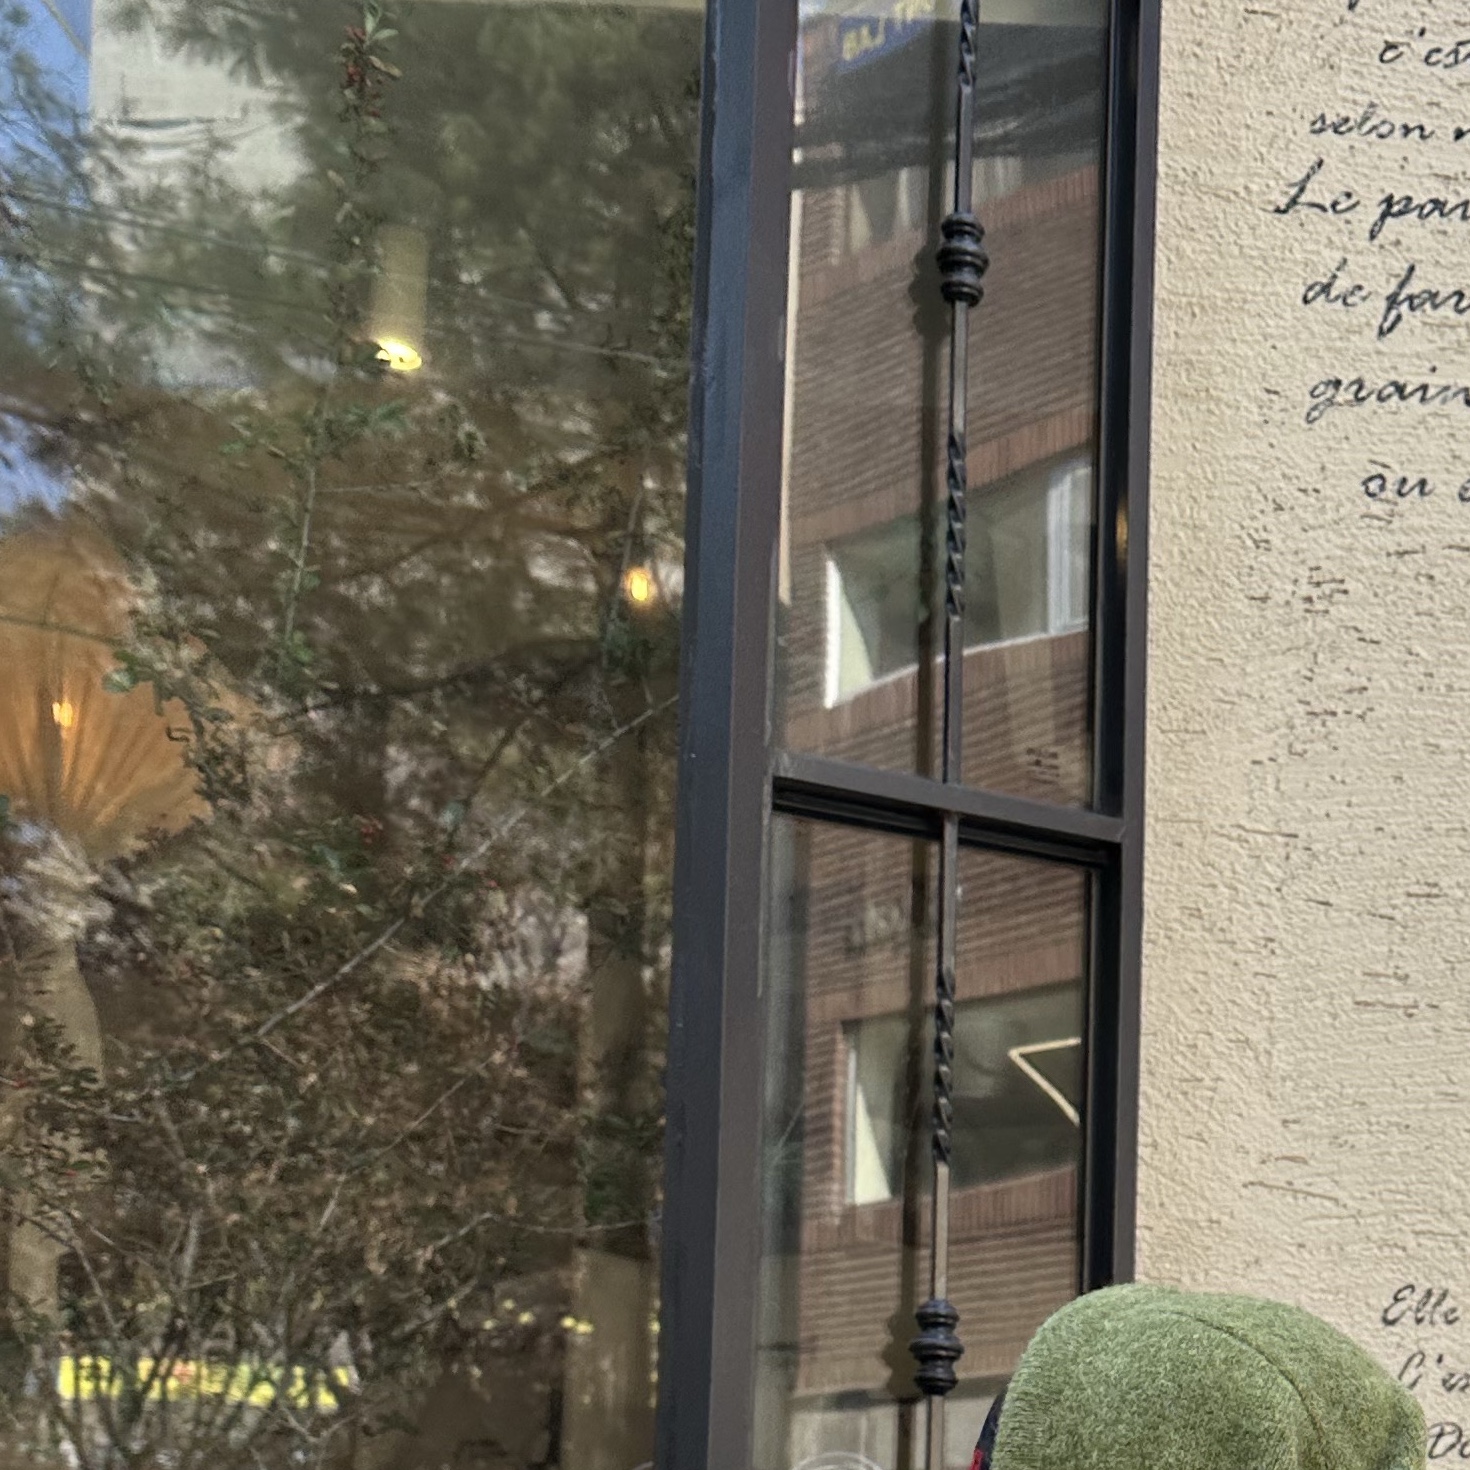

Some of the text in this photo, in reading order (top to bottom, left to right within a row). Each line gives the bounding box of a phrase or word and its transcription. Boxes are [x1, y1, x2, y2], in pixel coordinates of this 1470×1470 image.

[1310, 105, 1434, 142] selon
[1273, 158, 1360, 214] Le
[1301, 258, 1372, 307] de
[1381, 1285, 1460, 1327] Elle
